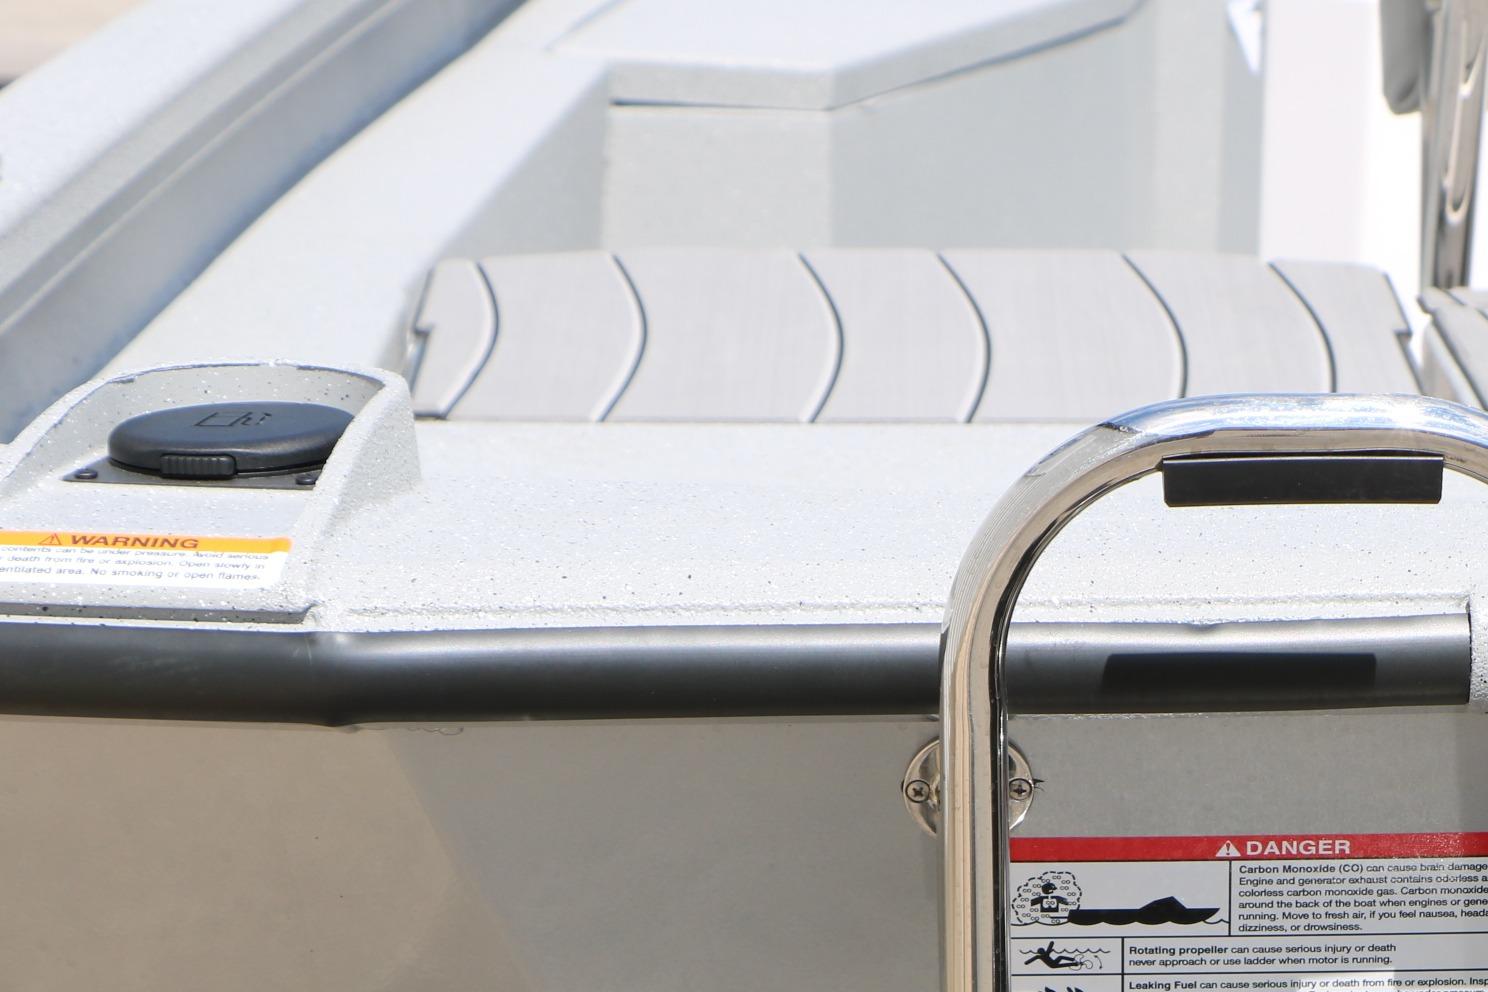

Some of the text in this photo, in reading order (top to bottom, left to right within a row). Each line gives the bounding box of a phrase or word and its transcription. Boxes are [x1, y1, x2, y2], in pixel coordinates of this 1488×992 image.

[71, 534, 199, 550] WARNING
[111, 570, 163, 578] smoking
[1246, 840, 1350, 855] DANGER
[1338, 865, 1364, 874] (CO)
[1447, 863, 1488, 872] damage
[1239, 878, 1274, 887] Engine
[1298, 876, 1347, 886] generator
[1376, 889, 1398, 897] gas.
[1408, 898, 1448, 908] engines
[1238, 912, 1279, 922] running.
[1352, 911, 1366, 920] air,
[1419, 911, 1458, 919] nausea,
[1238, 924, 1287, 933] dizziness,
[1129, 946, 1176, 956] Rotating
[1178, 946, 1229, 956] propeller
[1324, 945, 1352, 954] injury
[1158, 958, 1207, 967] approach
[1352, 956, 1392, 965] running.
[1129, 982, 1171, 991] Leaking
[1290, 980, 1316, 989] injury
[1417, 978, 1466, 987] explosion.
